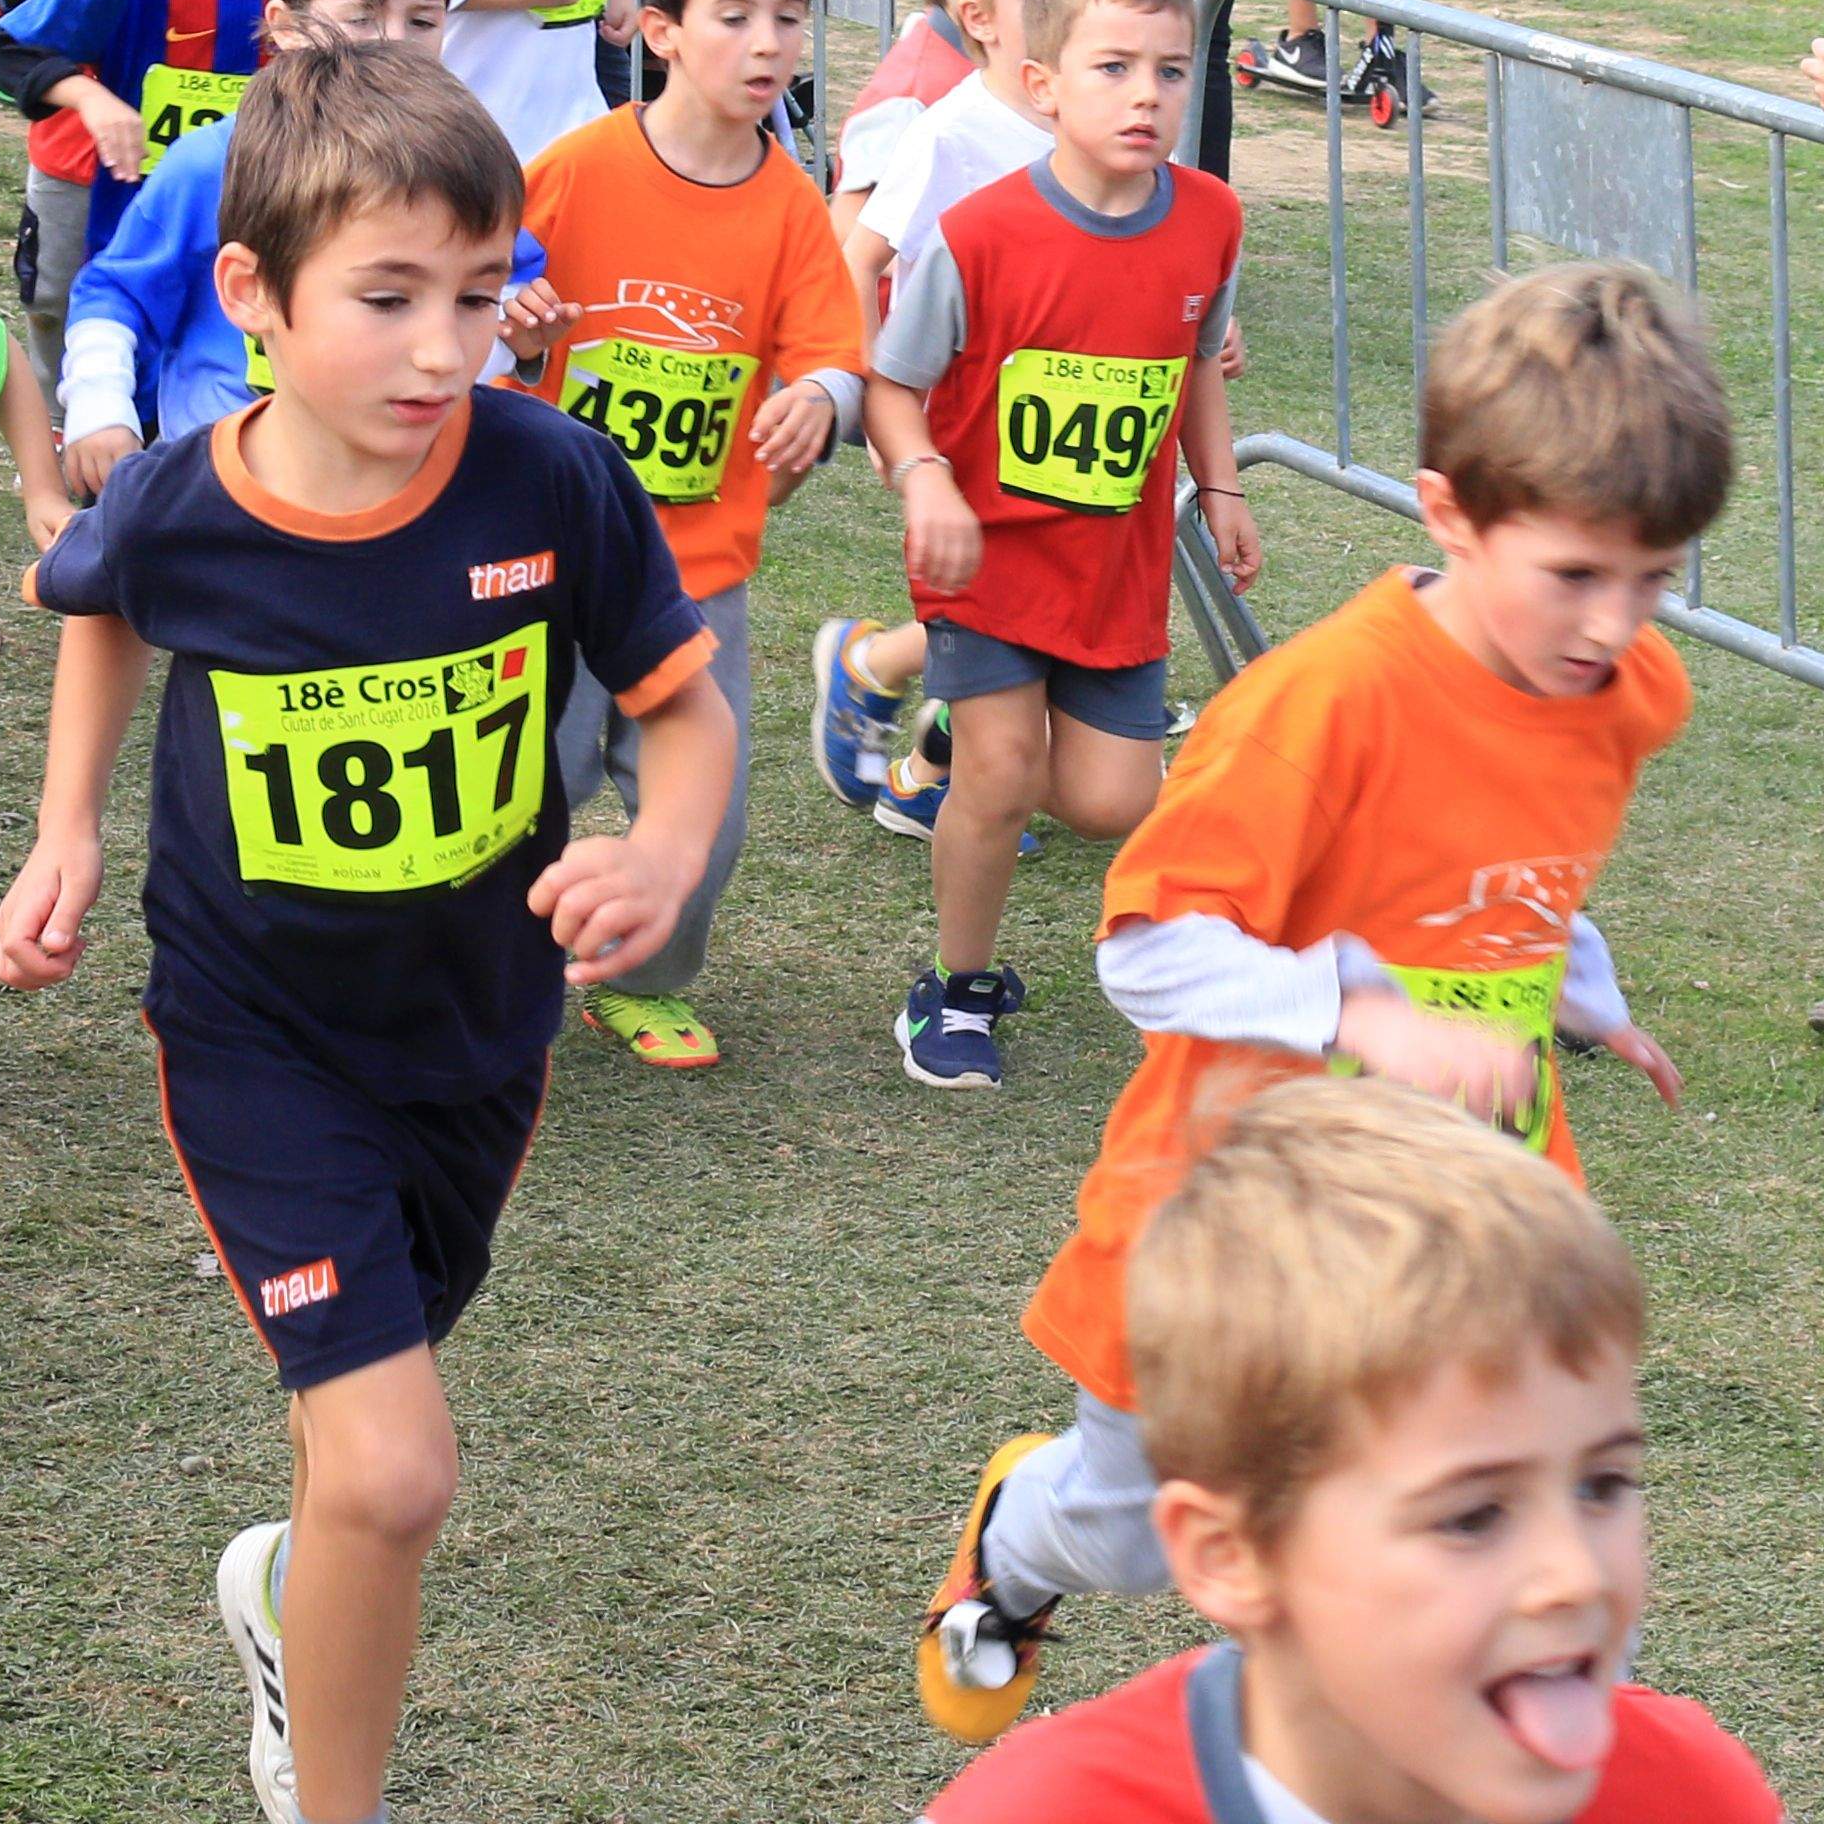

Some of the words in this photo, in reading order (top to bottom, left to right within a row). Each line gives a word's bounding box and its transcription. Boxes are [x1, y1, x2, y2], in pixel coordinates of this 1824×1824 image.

[177, 74, 212, 92] 18è
[219, 77, 248, 94] Cro
[611, 342, 652, 369] 18è
[660, 354, 703, 378] Cros
[1043, 357, 1084, 380] 18è
[1092, 362, 1138, 385] Cros
[567, 378, 733, 468] 4395
[469, 557, 549, 601] thau
[277, 678, 345, 713] 18è
[359, 674, 437, 705] Cros
[281, 714, 316, 733] Ciutat
[319, 716, 335, 731] de
[337, 710, 366, 728] Sant
[368, 705, 405, 729] Cugat
[407, 699, 441, 722] 2016
[244, 692, 530, 851] 1817
[261, 1264, 329, 1318] thau
